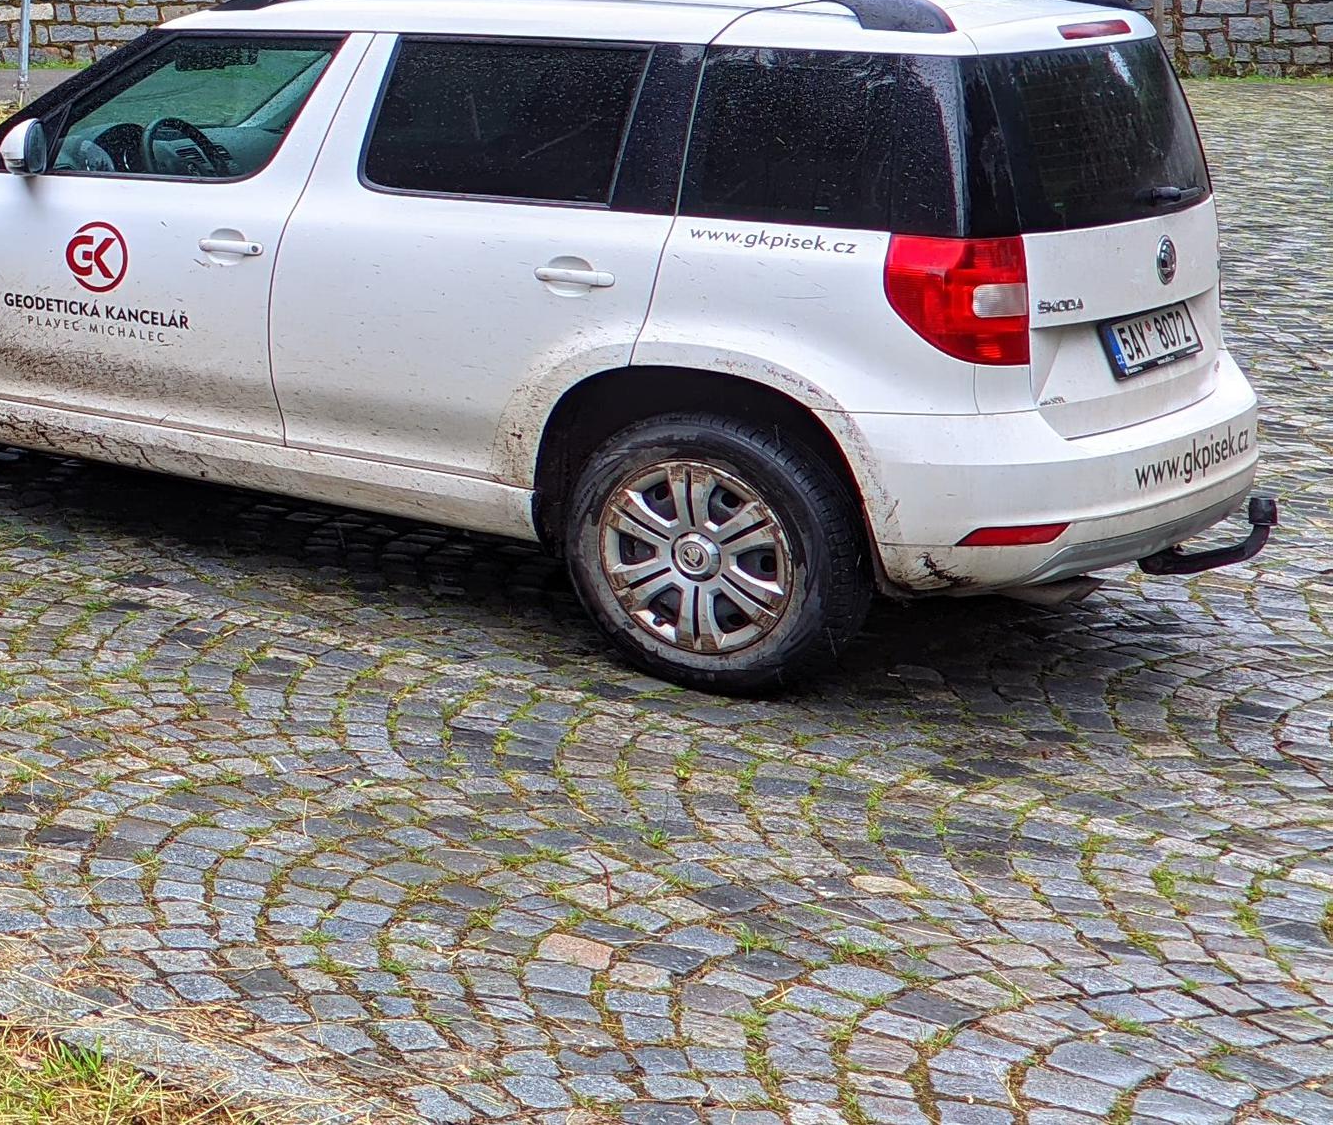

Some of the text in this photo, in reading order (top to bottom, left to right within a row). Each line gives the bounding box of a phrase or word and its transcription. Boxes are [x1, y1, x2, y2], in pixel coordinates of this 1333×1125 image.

[65, 234, 117, 279] GK
[690, 228, 859, 254] www.gkpisek.cz
[4, 292, 190, 330] GEODETICKÁ KANCELÁŘ
[27, 315, 166, 343] PLAVEC-MICHALEC
[1117, 310, 1192, 361] 5AY 8072
[1134, 425, 1249, 489] www.gkpisek.cz
